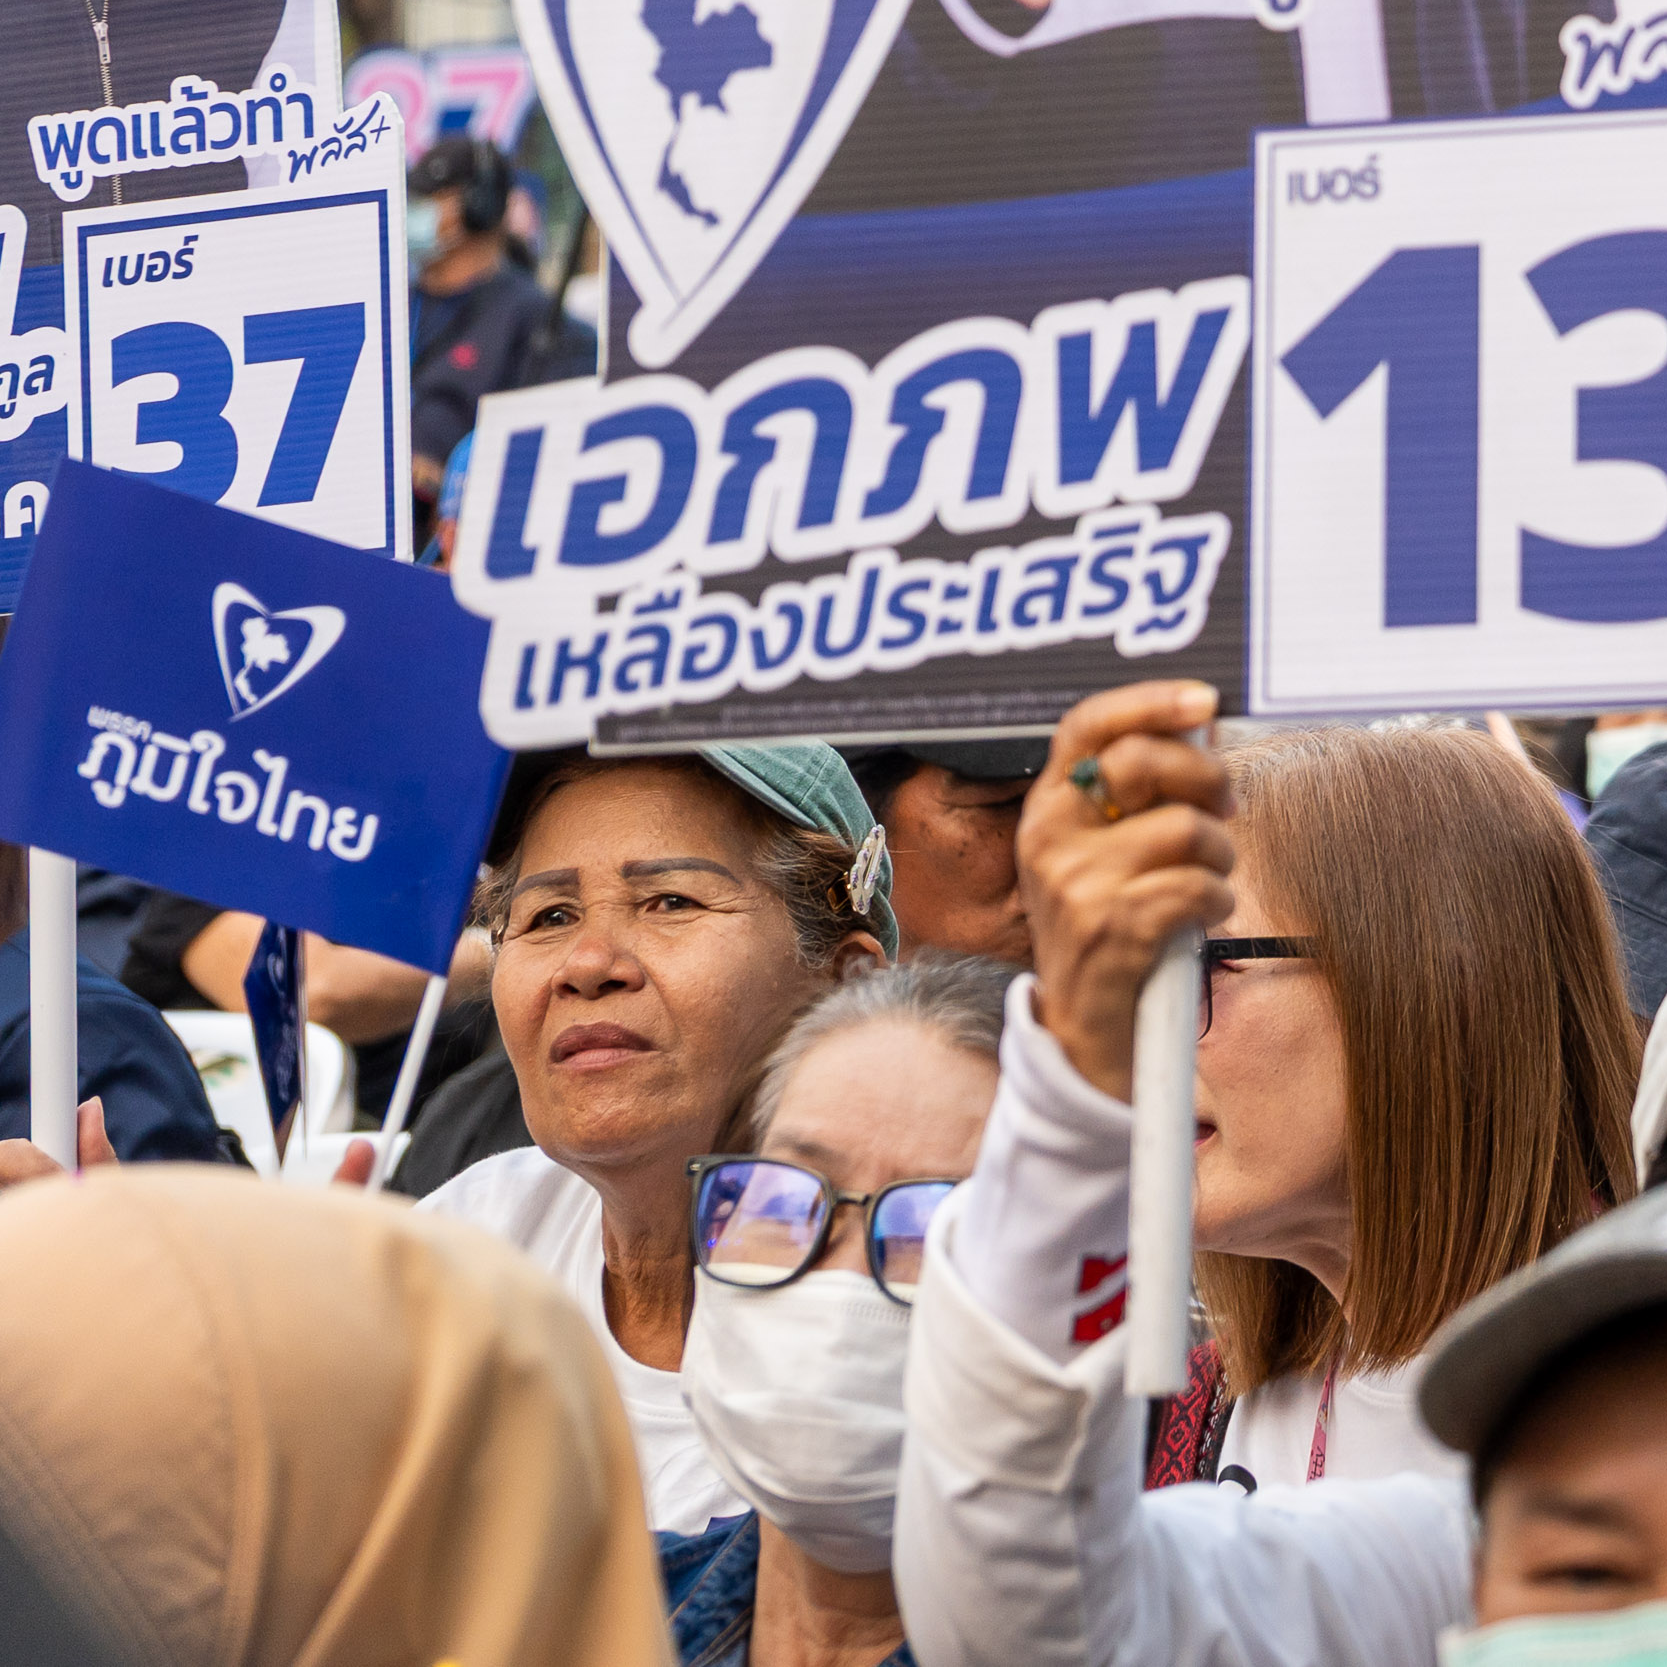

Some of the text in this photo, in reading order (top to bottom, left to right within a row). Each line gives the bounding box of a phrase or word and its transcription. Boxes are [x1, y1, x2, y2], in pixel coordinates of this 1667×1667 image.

[37, 71, 316, 191] พูดแล้วทำ
[1287, 152, 1382, 203] เบอร์
[101, 233, 200, 289] เบอร์
[111, 301, 366, 508] 37
[484, 304, 1234, 582] เอกภพ
[514, 520, 1212, 712] เหลืองประเสริฐ
[77, 730, 379, 863] ภูมิใจไทย
